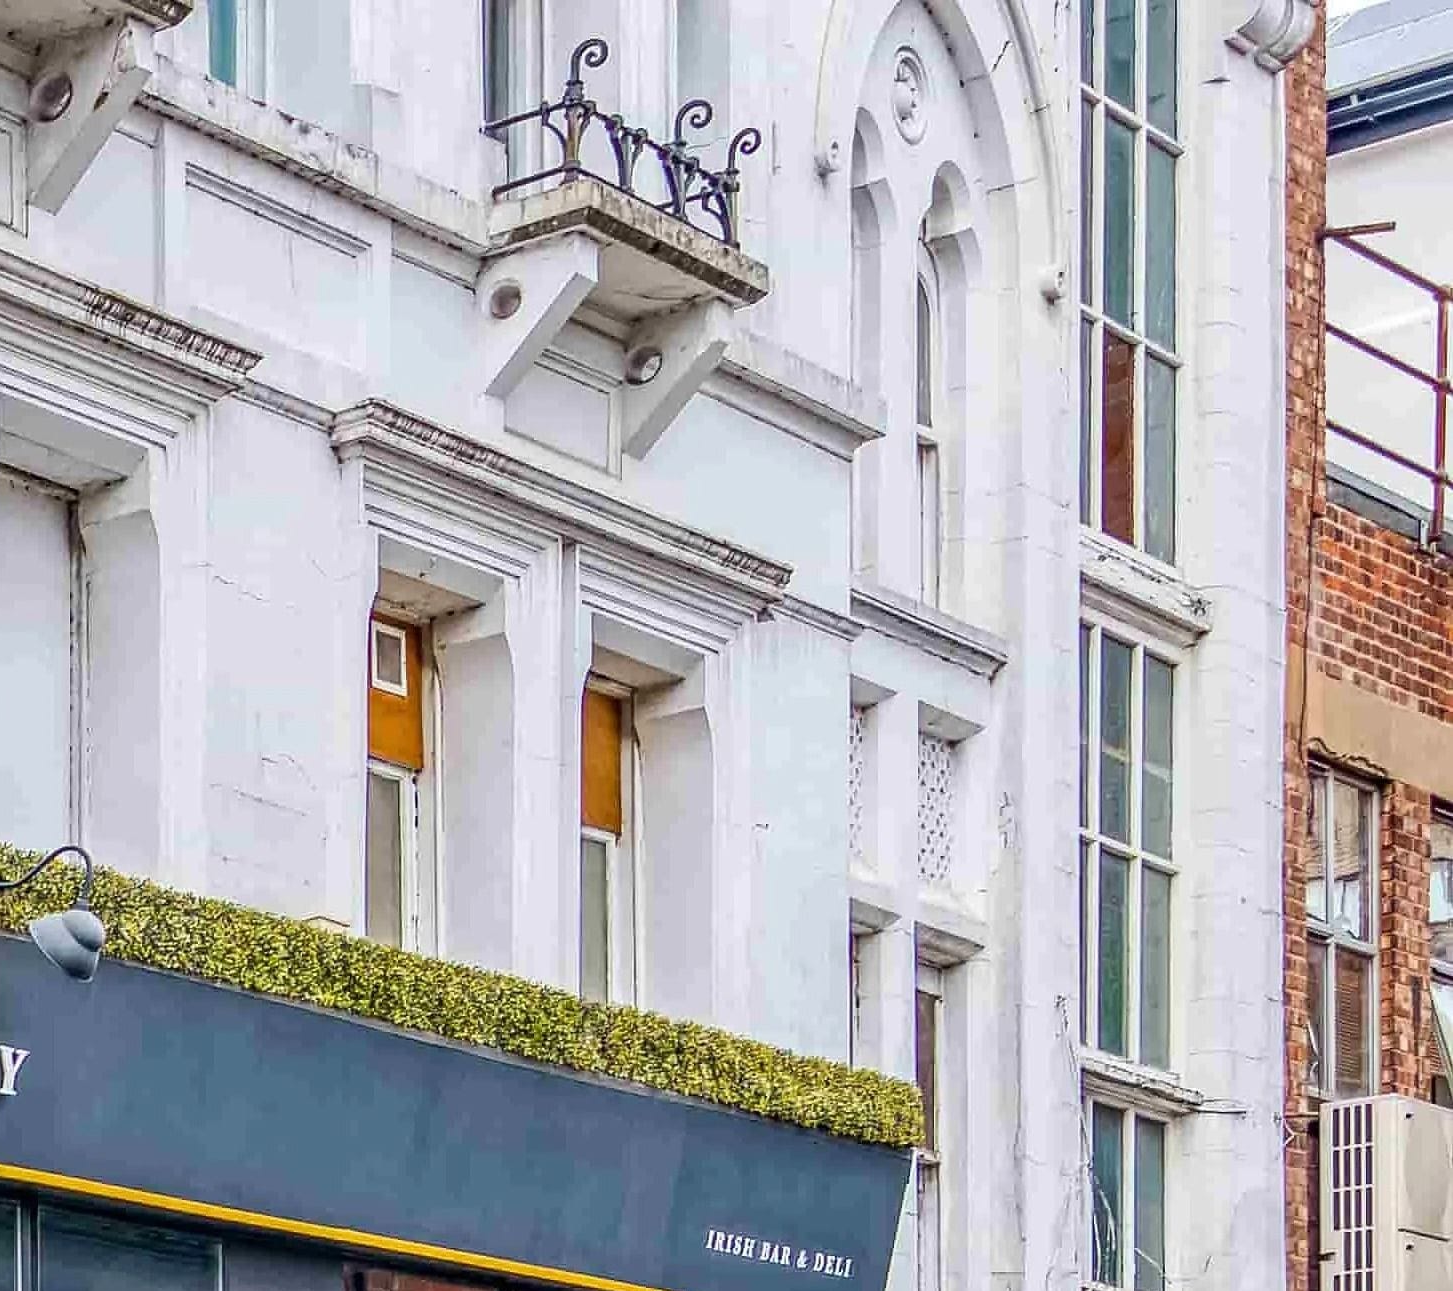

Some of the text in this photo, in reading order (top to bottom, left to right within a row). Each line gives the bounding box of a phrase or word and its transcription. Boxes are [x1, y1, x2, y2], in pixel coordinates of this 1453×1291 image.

[706, 1230, 853, 1278] IRISH BAR & DELI
